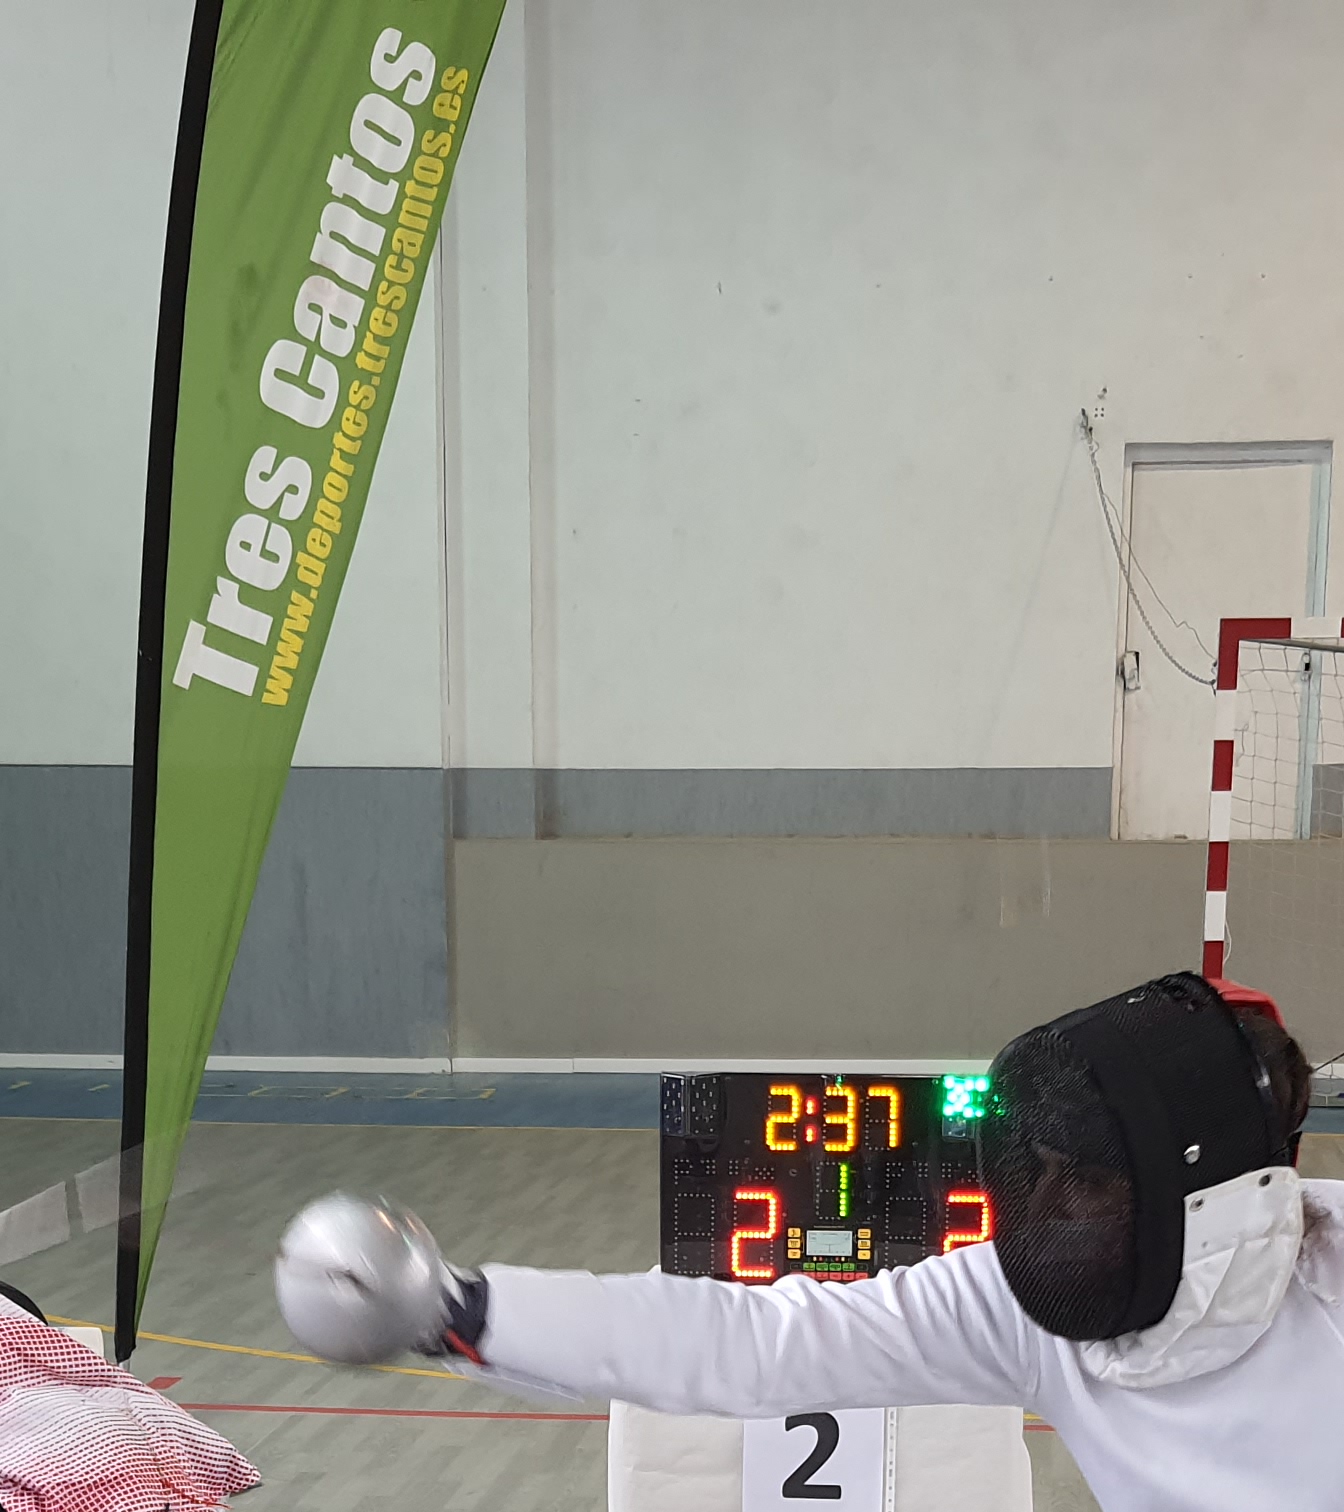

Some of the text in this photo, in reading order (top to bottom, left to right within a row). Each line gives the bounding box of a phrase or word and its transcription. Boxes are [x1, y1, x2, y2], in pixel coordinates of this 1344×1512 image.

[172, 27, 436, 697] Tres Cantos
[261, 66, 469, 706] www.deportes.trescantos.es
[765, 1085, 899, 1151] 2:37
[730, 1190, 778, 1278] 2
[942, 1194, 990, 1254] 2
[782, 1411, 842, 1500] 2
